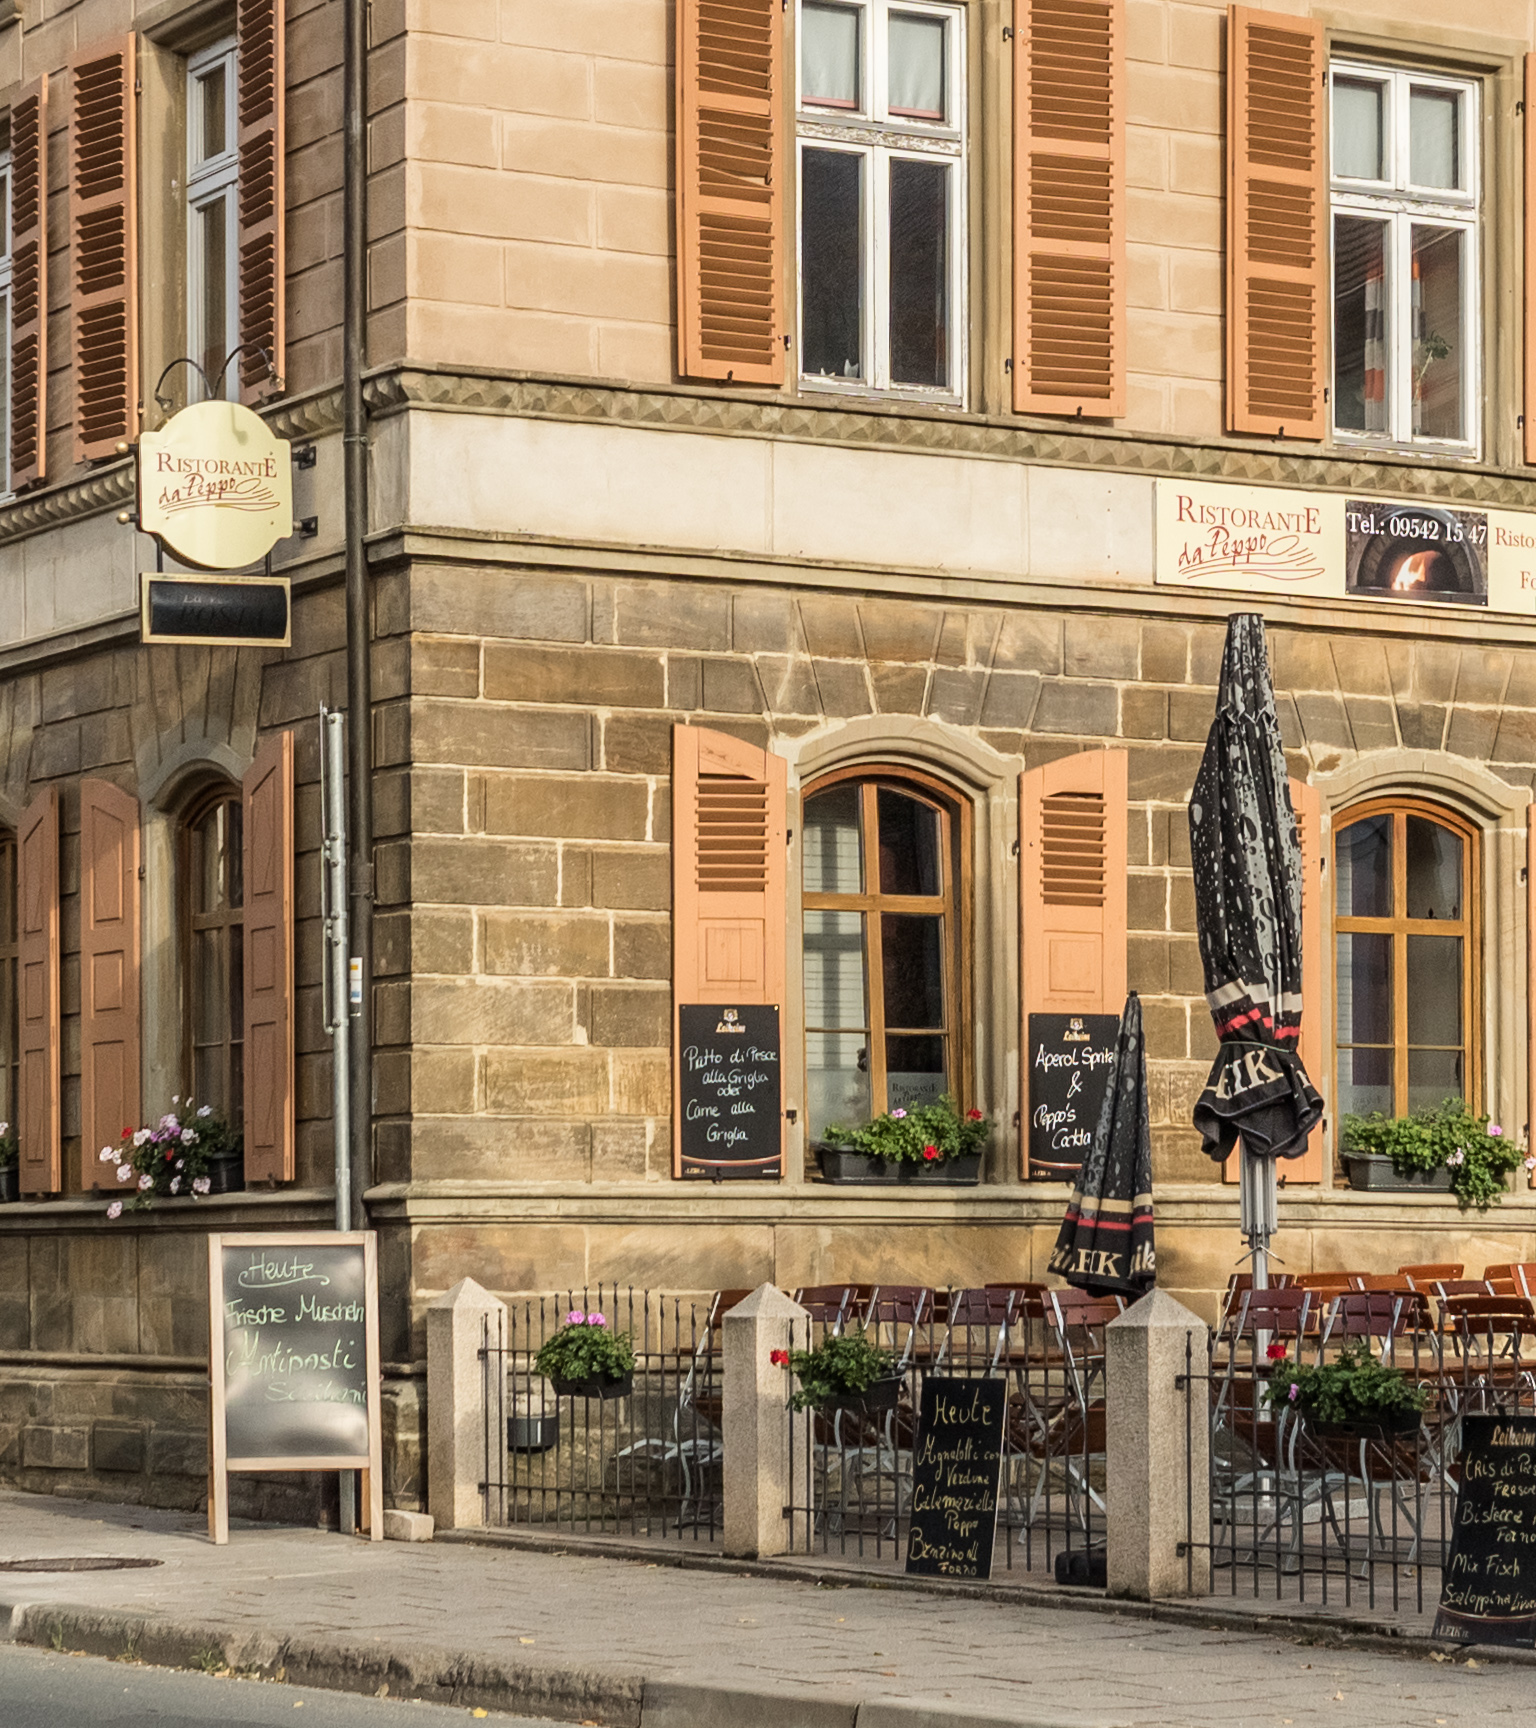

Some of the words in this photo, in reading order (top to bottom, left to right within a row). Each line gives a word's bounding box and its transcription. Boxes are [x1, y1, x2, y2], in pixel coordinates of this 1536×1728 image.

[156, 452, 278, 478] RISTORANTE
[159, 485, 182, 504] da
[182, 472, 236, 502] Peppo
[1176, 494, 1322, 535] RISTORANTE
[1346, 511, 1385, 536] Tel.:
[1389, 516, 1440, 540] 09542
[1446, 522, 1464, 543] 15
[1468, 524, 1487, 545] 47
[1178, 542, 1204, 567] da
[1204, 525, 1267, 567] Peppo
[729, 1048, 745, 1063] di
[702, 1069, 727, 1084] alla
[717, 1083, 742, 1097] oder
[1067, 1071, 1083, 1099] &
[730, 1101, 756, 1115] alla
[1034, 1102, 1076, 1132] Peppo's
[247, 1252, 316, 1282] Heute
[225, 1298, 288, 1325] Frische
[932, 1387, 992, 1427] Heute
[1490, 1425, 1536, 1446] Leikeim
[1452, 1553, 1478, 1573] Mix
